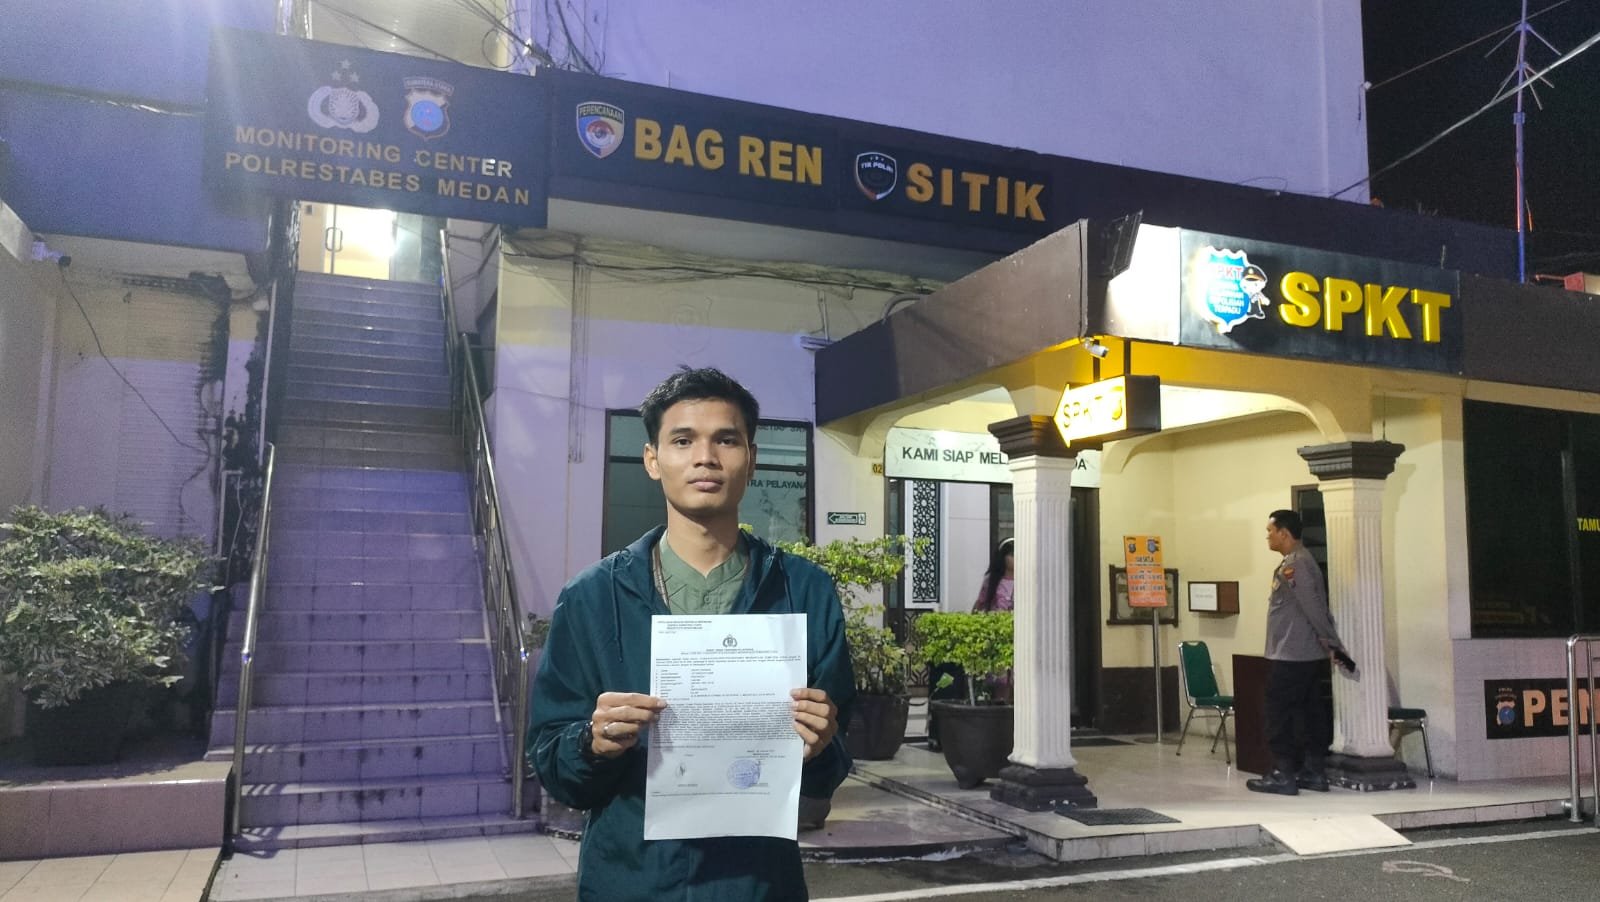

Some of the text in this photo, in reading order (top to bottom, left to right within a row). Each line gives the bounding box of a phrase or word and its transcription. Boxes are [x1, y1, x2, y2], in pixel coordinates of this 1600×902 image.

[224, 152, 530, 206] POLRESTABES MEDAN
[235, 126, 513, 178] MONITORING CENTER
[634, 119, 822, 186] BAG REN
[906, 163, 1046, 222] SITIK
[1279, 271, 1451, 343] SPKT
[902, 446, 939, 462] KAMI
[943, 449, 974, 463] SIAP
[979, 453, 1009, 465] MEL
